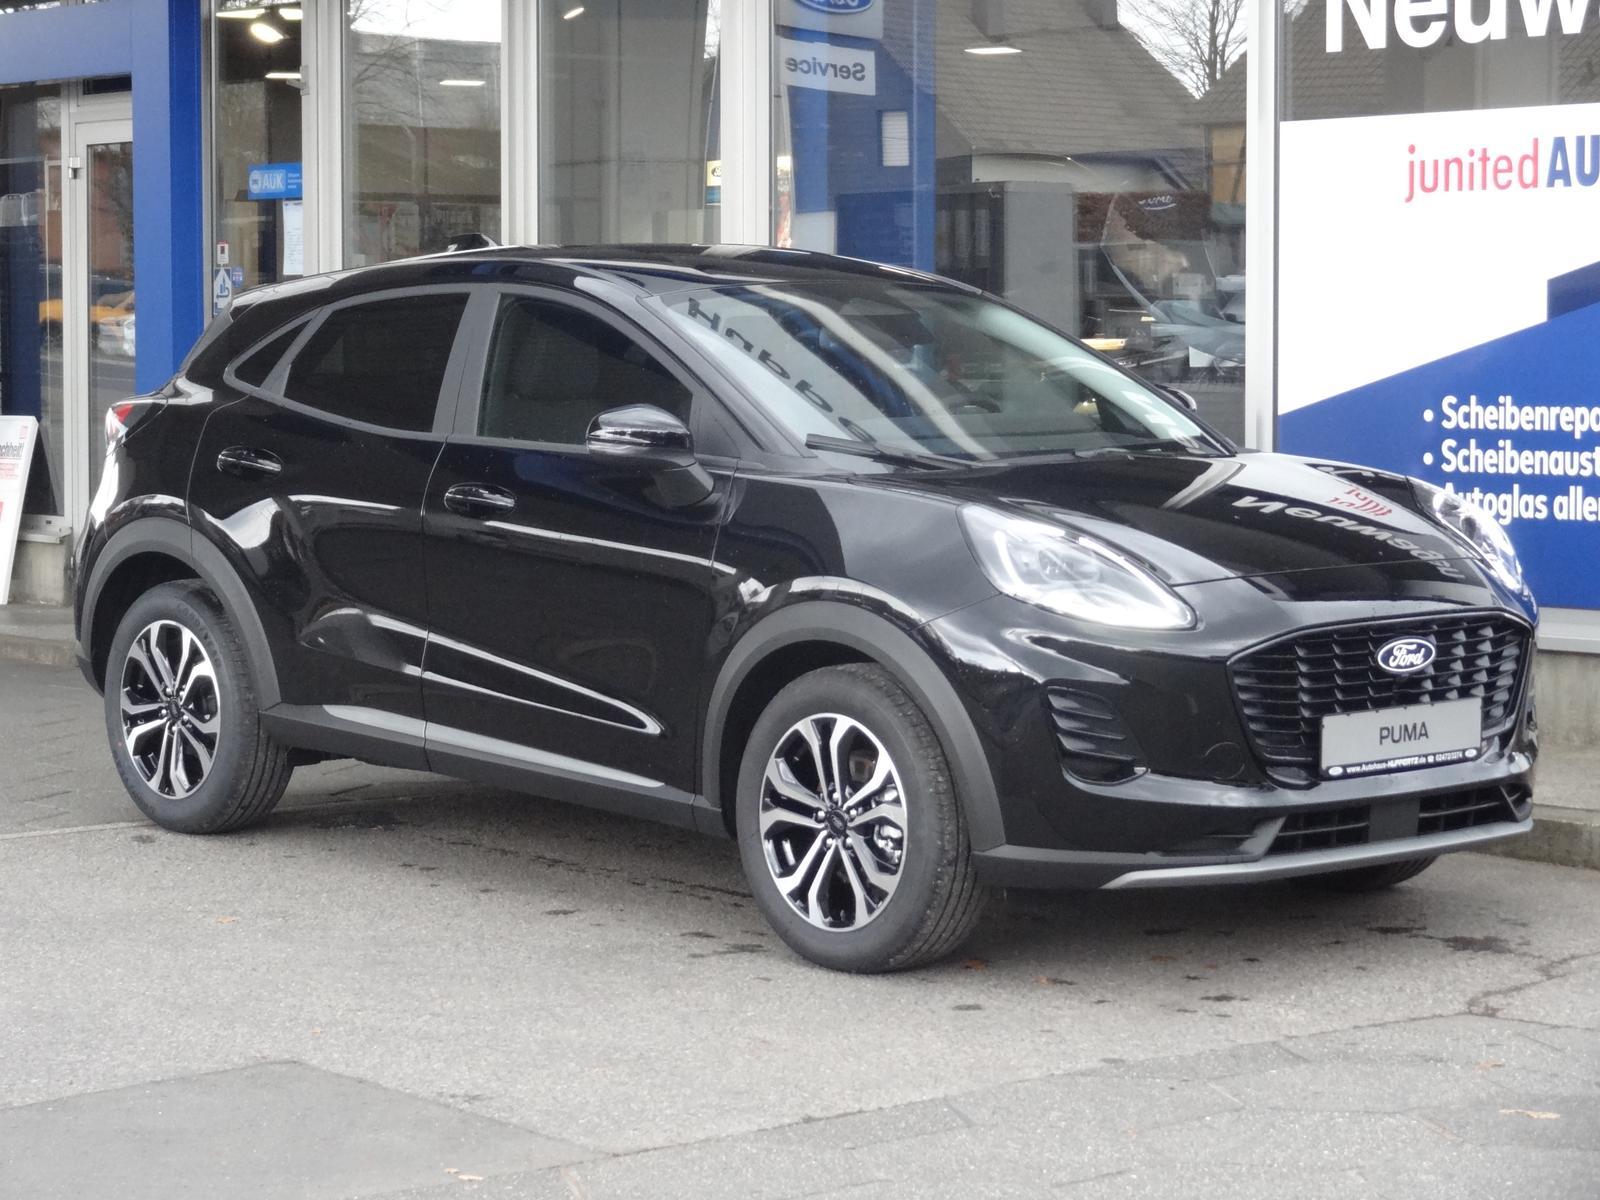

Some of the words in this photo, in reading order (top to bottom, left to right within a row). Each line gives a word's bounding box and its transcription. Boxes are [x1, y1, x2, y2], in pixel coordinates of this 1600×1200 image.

[1325, 0, 1600, 53] Neuw
[1553, 485, 1600, 522] alle
[1387, 642, 1427, 669] Ford
[1379, 721, 1429, 745] PUMA
